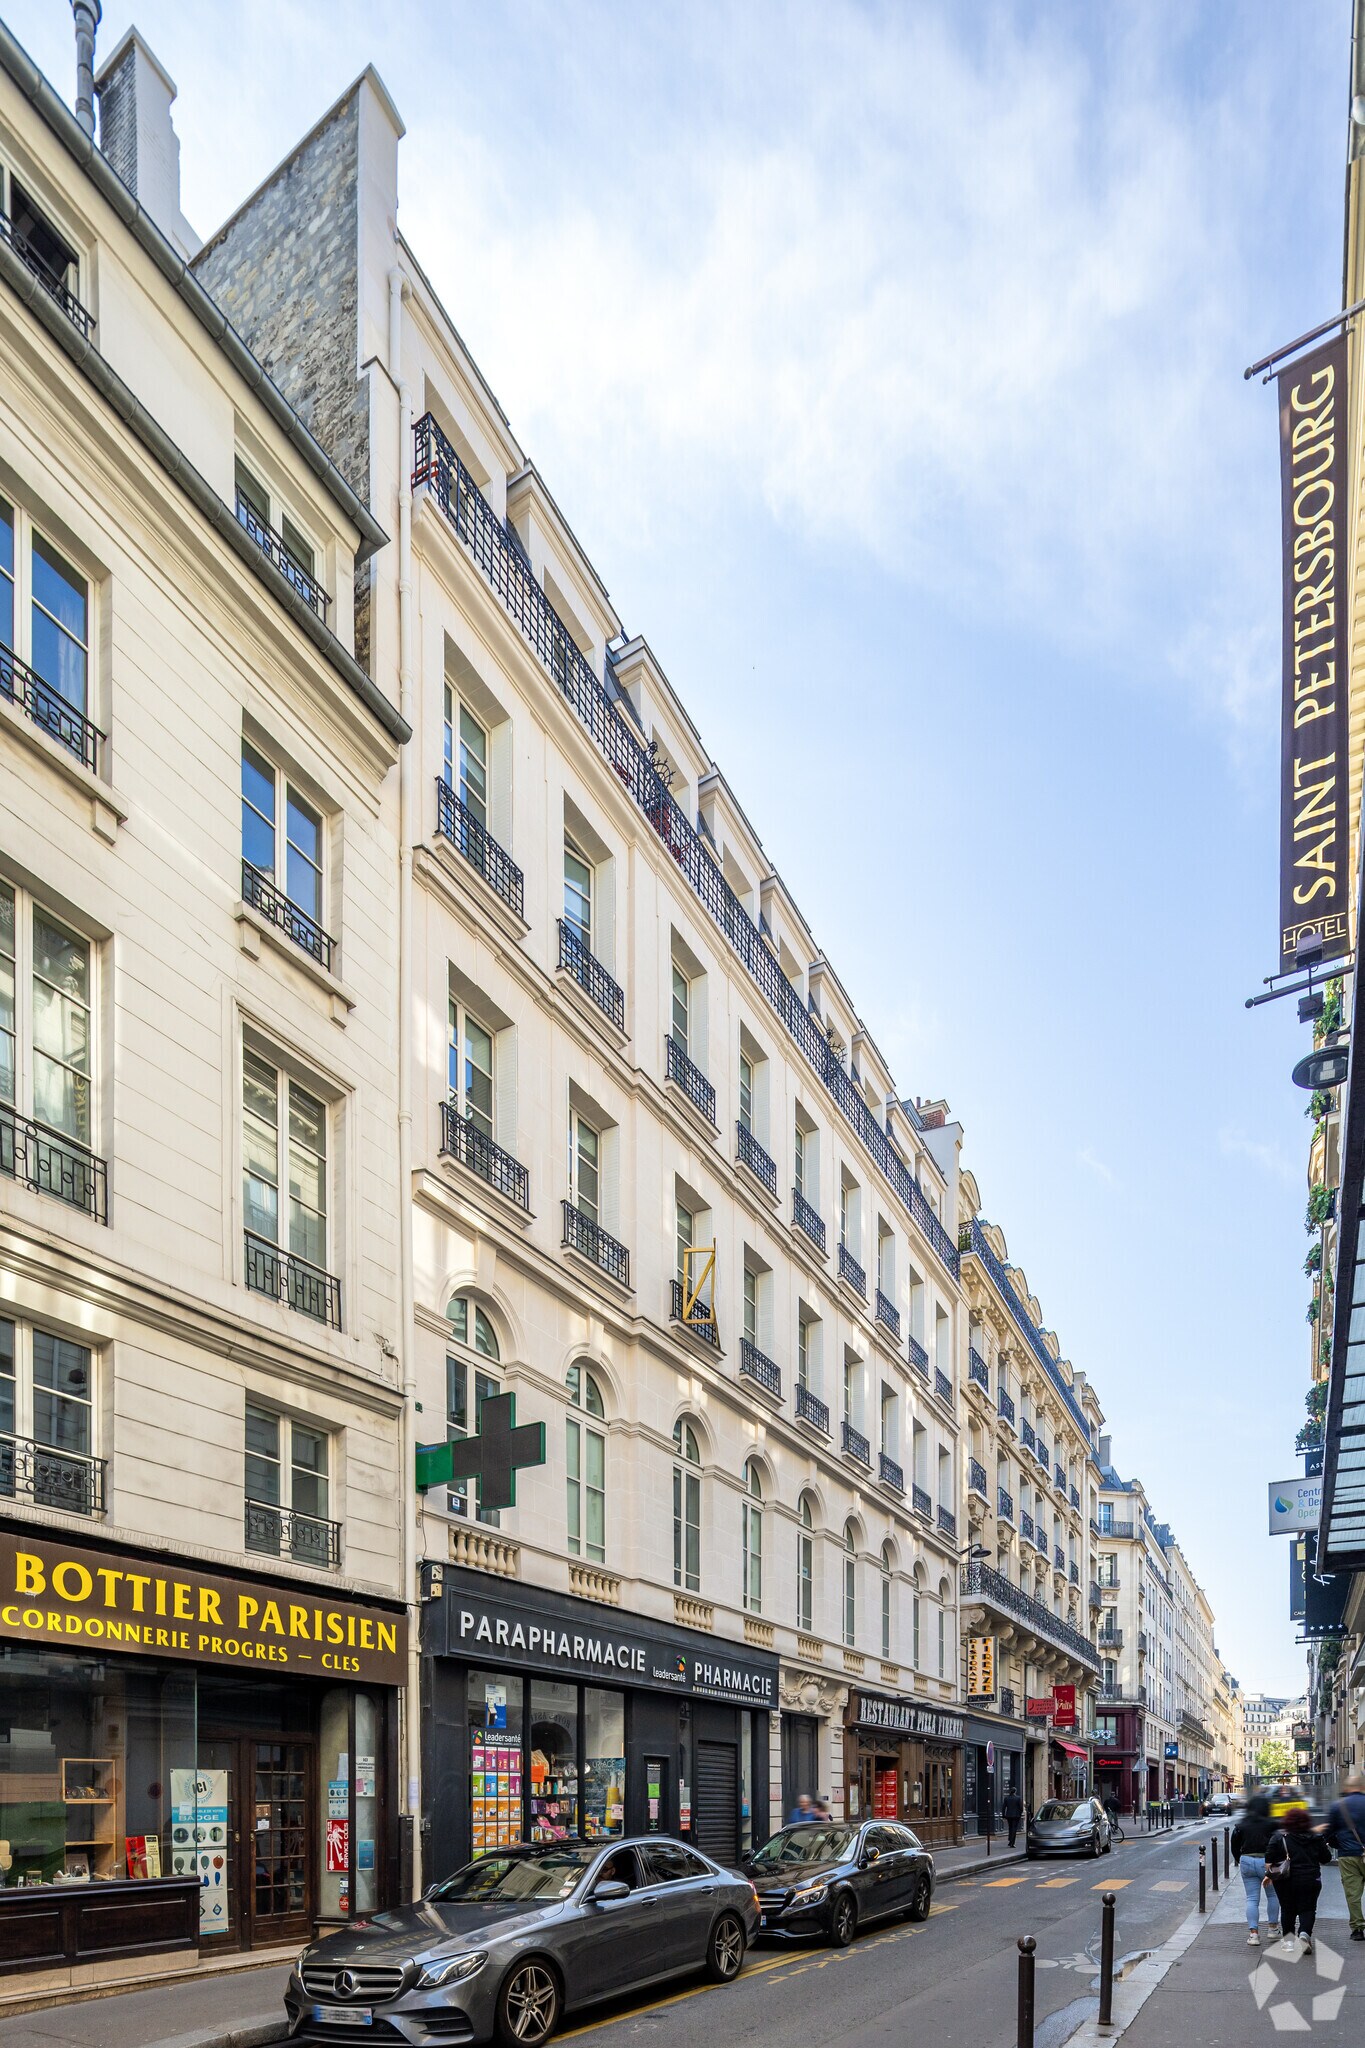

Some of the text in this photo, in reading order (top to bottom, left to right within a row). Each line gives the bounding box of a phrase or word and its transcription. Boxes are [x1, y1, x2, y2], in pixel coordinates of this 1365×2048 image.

[1291, 364, 1336, 904] SAINT PETERSBOURG
[1297, 1508, 1321, 1520] Opér
[1308, 1498, 1321, 1507] De
[14, 1551, 398, 1654] BOTTIER PARISIEN
[1, 1605, 191, 1650] CORDONNERIE
[198, 1634, 289, 1663] PROGRES
[321, 1652, 361, 1673] CLES
[459, 1611, 646, 1673] PARAPHARMACIE
[982, 1637, 993, 1693] FIRENZE
[694, 1661, 772, 1696] PHARMACIE
[860, 1697, 964, 1739] RESTAURANT PIZZA FIRENZE
